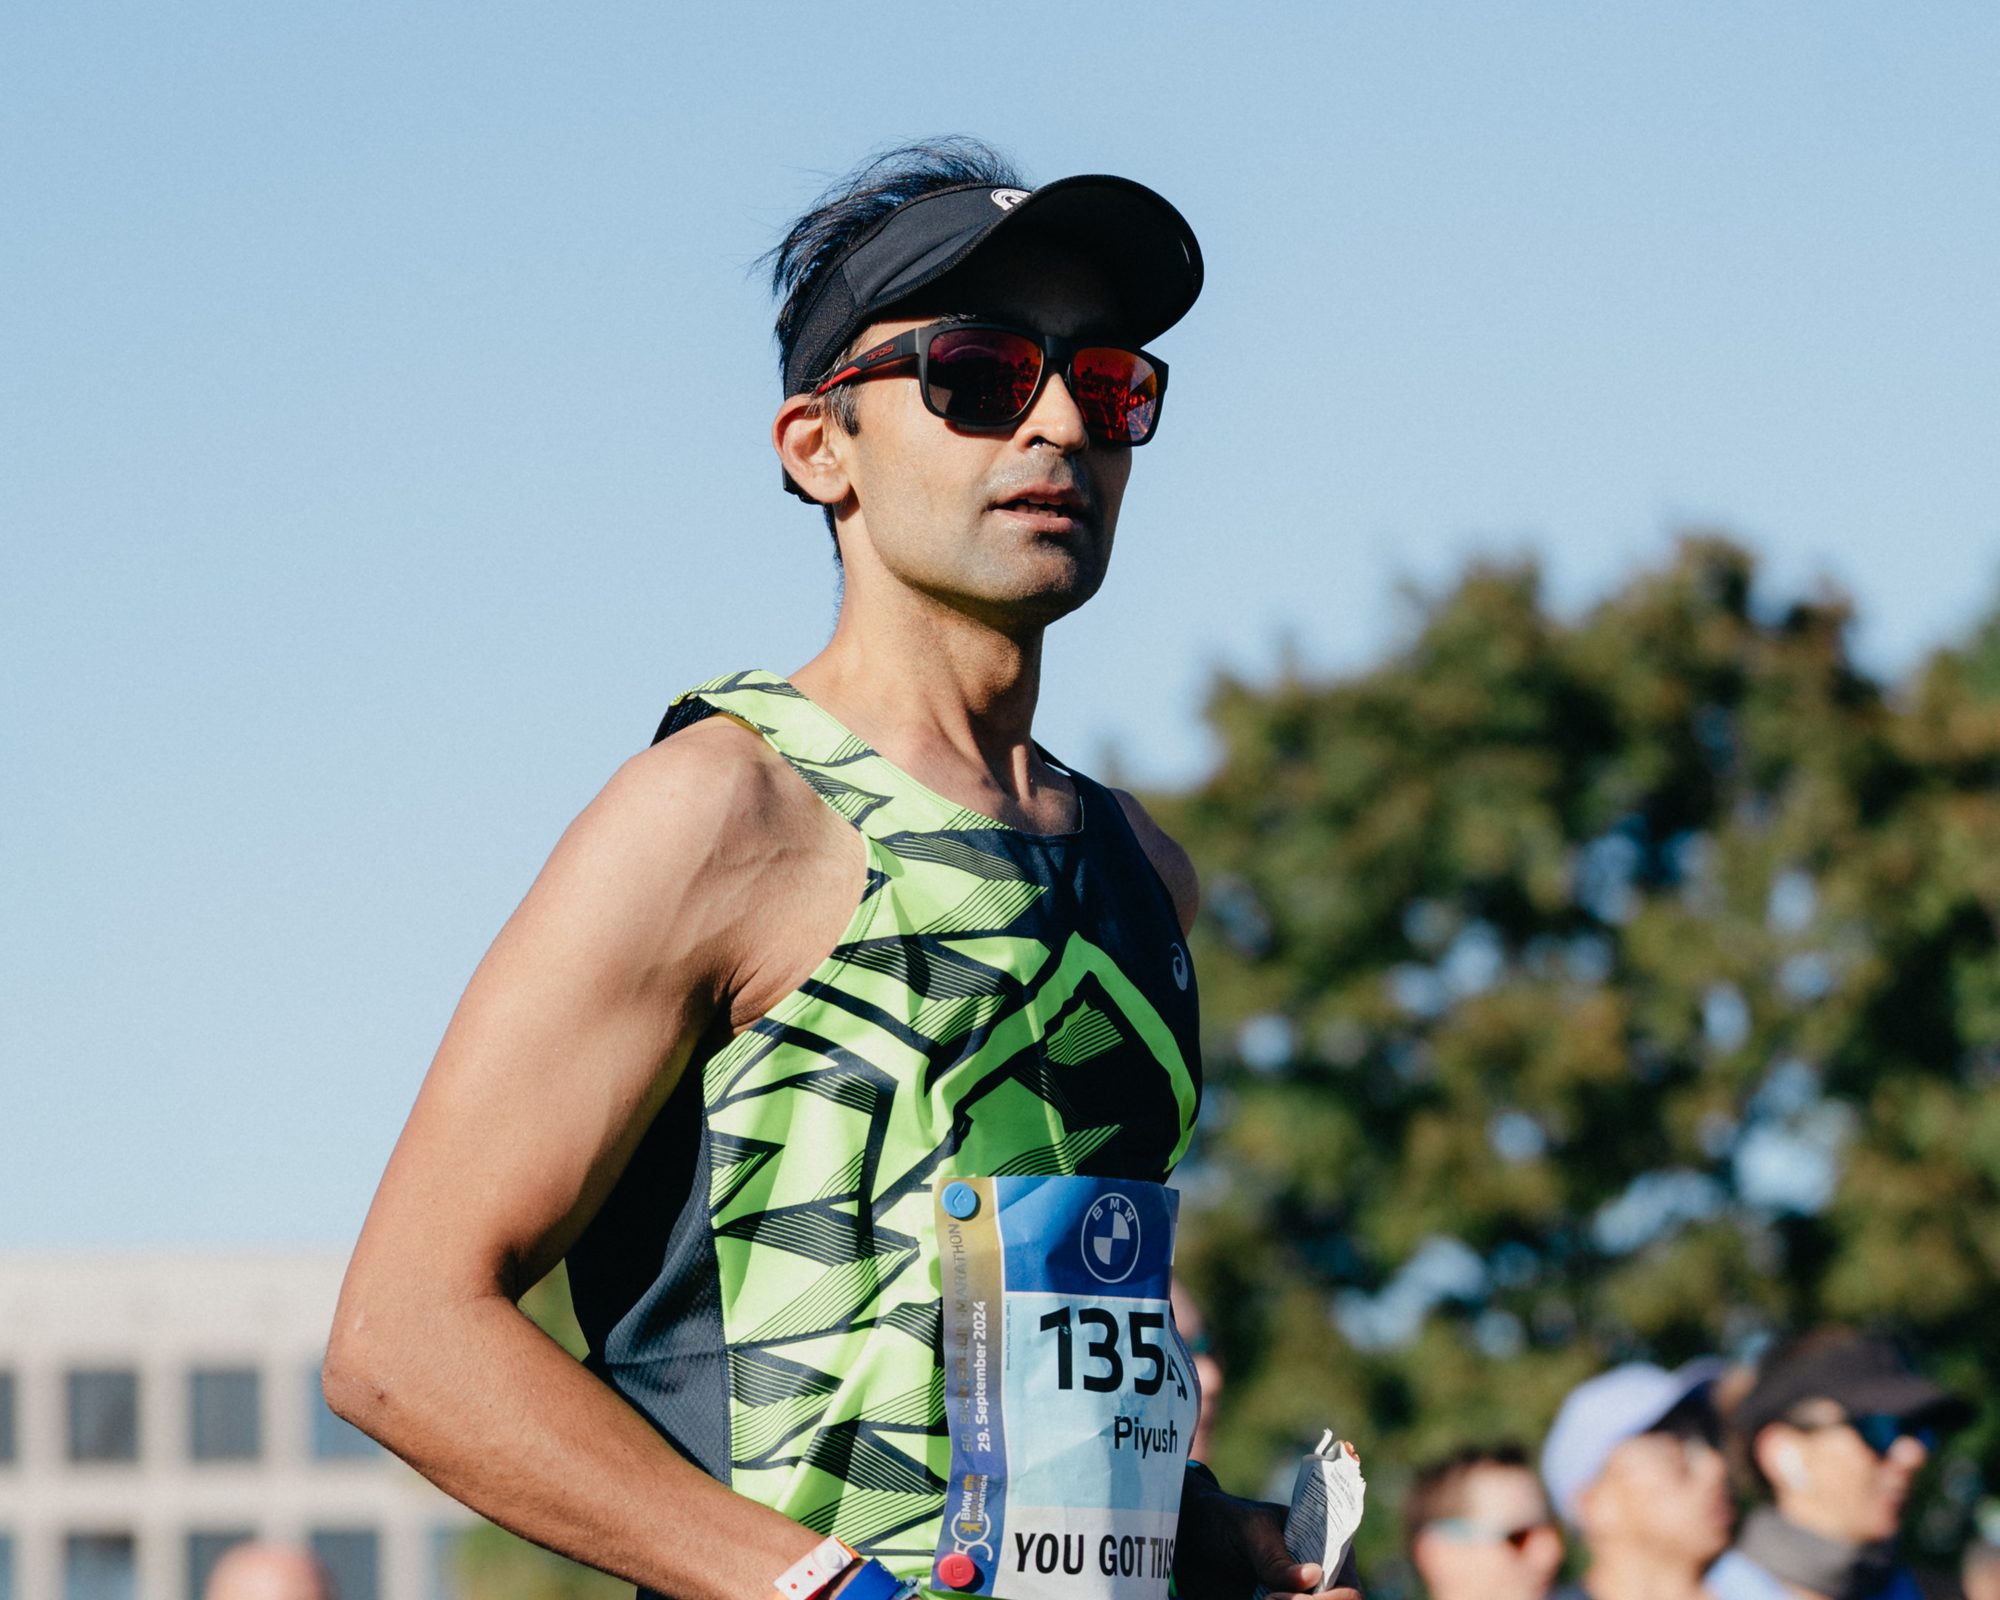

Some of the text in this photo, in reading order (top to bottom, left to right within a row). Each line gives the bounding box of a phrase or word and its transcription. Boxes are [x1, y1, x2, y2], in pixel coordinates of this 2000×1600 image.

[1092, 1198, 1135, 1222] BMW
[972, 1301, 991, 1453] 29. September 2024
[1114, 1416, 1178, 1459] Piyush
[961, 1491, 973, 1521] BMW
[976, 1474, 988, 1521] MARATHON
[951, 1512, 993, 1561] 50
[1015, 1533, 1084, 1575] YOU
[1099, 1534, 1146, 1577] GOT
